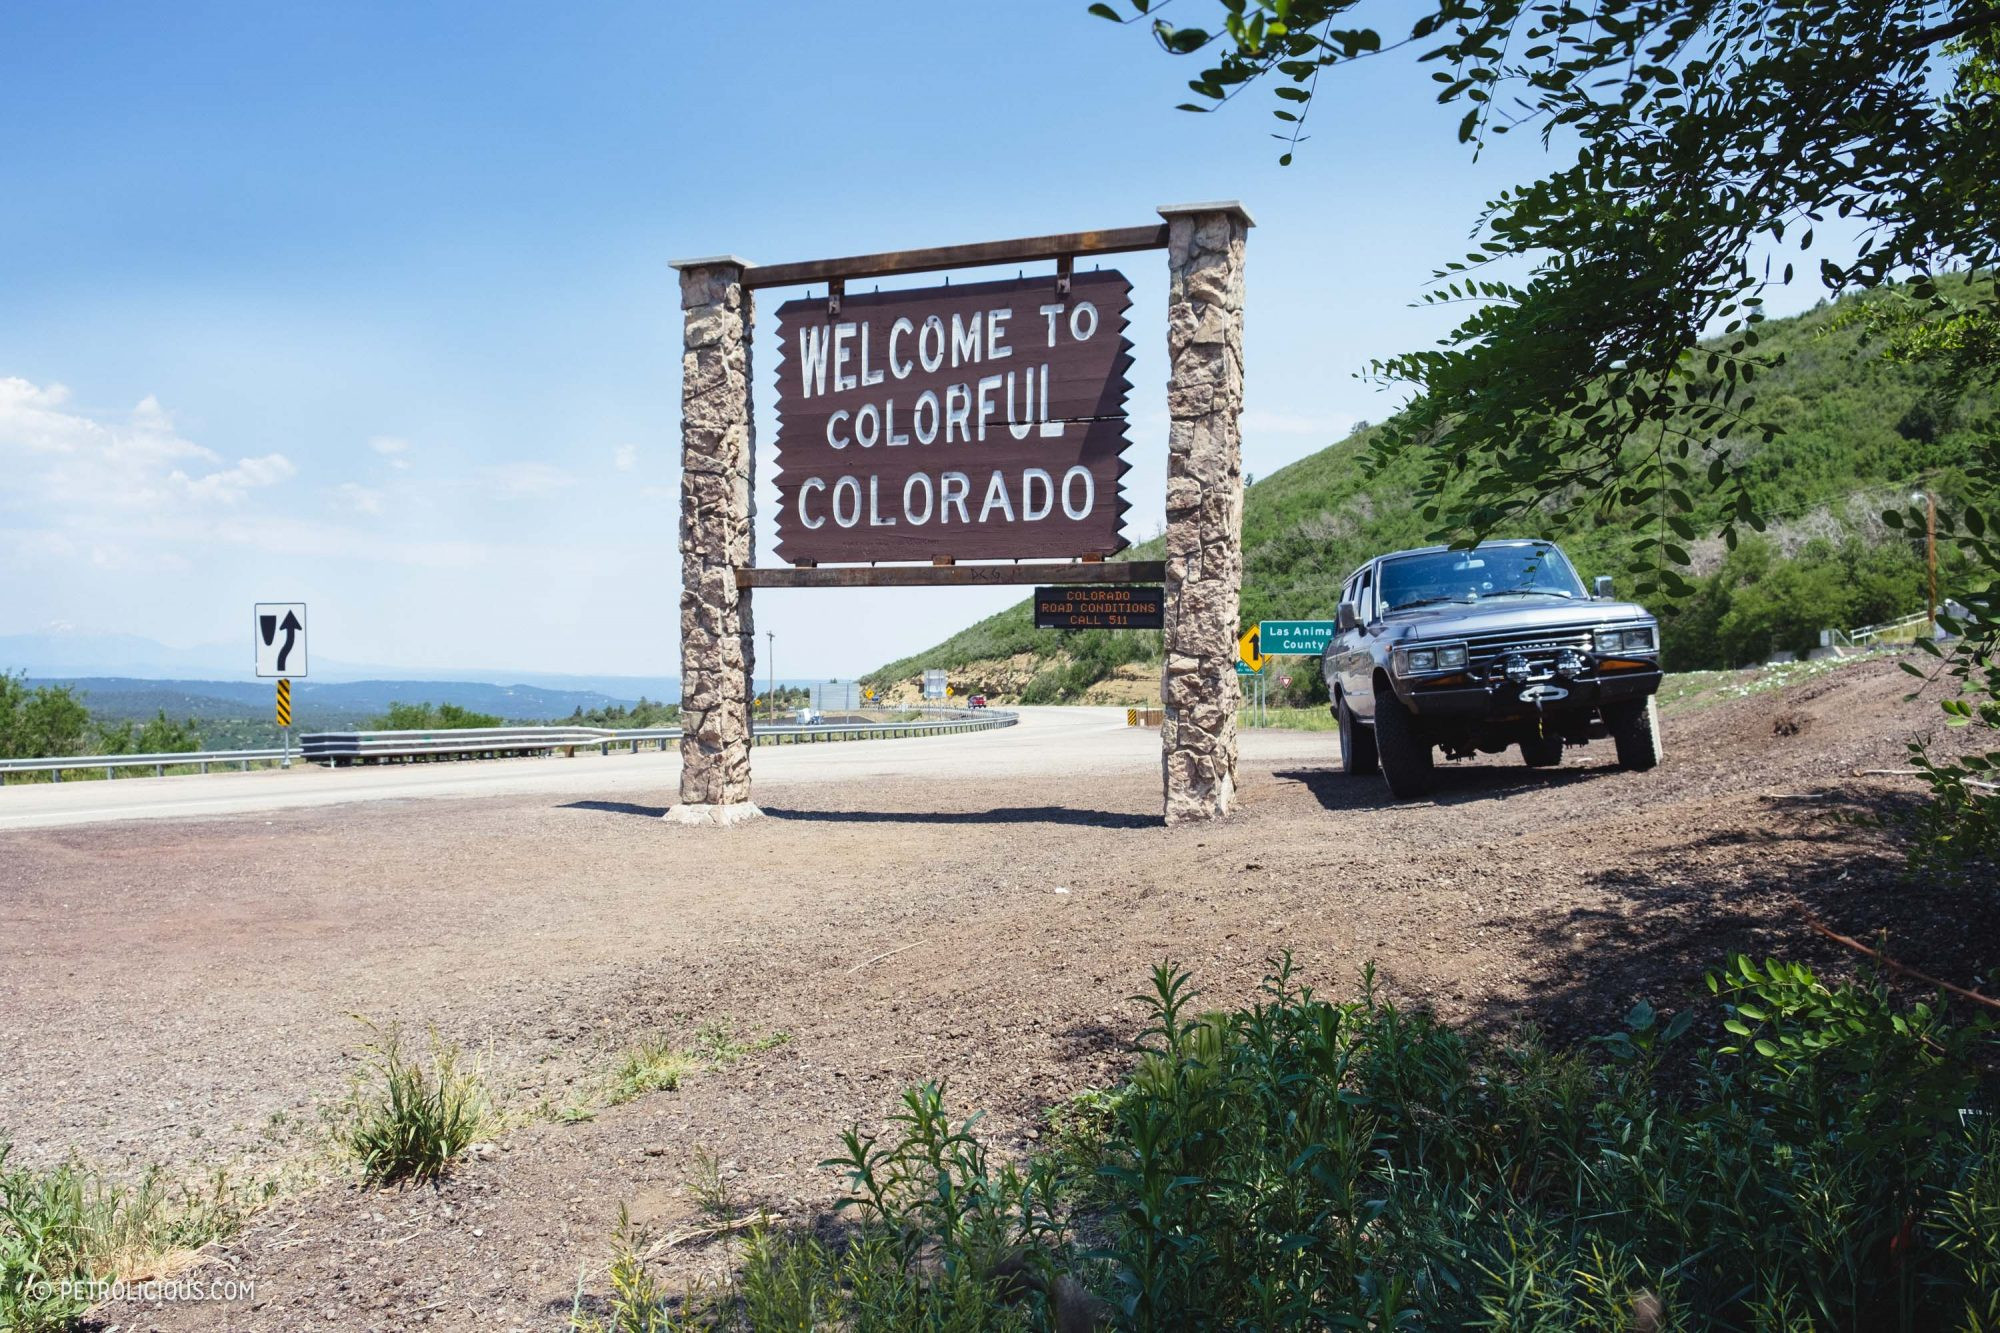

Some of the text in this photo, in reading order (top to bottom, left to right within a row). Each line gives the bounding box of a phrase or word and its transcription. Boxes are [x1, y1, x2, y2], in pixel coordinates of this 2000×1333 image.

[799, 301, 1099, 399] WELCOME TO
[826, 363, 1066, 450] COLORFUL
[798, 465, 1095, 530] COLORADO
[1066, 591, 1131, 600] COLORADO
[1041, 603, 1156, 613] ROAD CONDITIONS
[1070, 615, 1128, 625] CALL 511
[1269, 626, 1332, 636] Las Anima
[1283, 640, 1325, 650] County
[1507, 663, 1531, 674] PIAA
[1558, 659, 1582, 670] PIAA
